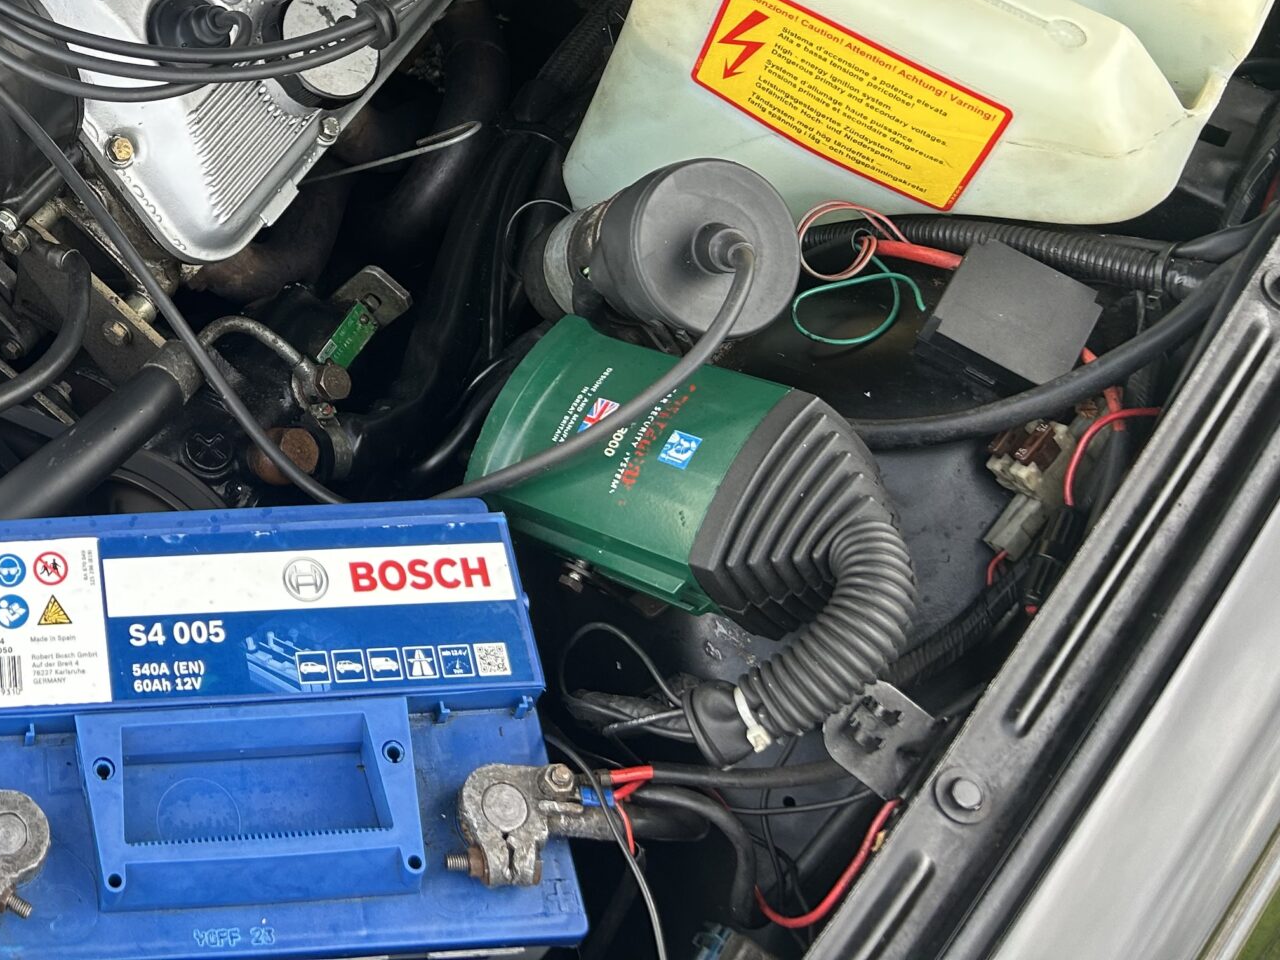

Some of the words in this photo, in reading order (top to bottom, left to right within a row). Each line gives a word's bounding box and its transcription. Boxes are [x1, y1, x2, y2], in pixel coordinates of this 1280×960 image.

[799, 18, 844, 46] Caution!
[843, 40, 897, 73] Attention!
[896, 66, 948, 99] Achtung!
[947, 92, 997, 124] Varning!
[566, 395, 583, 414] GREAT
[576, 398, 589, 413] AND
[551, 416, 570, 442] BRITAIN
[631, 406, 661, 448] SECURITY
[348, 555, 491, 592] BOSCH
[129, 623, 166, 646] S4
[172, 619, 225, 644] 005
[132, 662, 169, 676] 540A
[173, 660, 205, 675] (EN)
[133, 678, 170, 692] 60Ah
[174, 677, 202, 690] 12V
